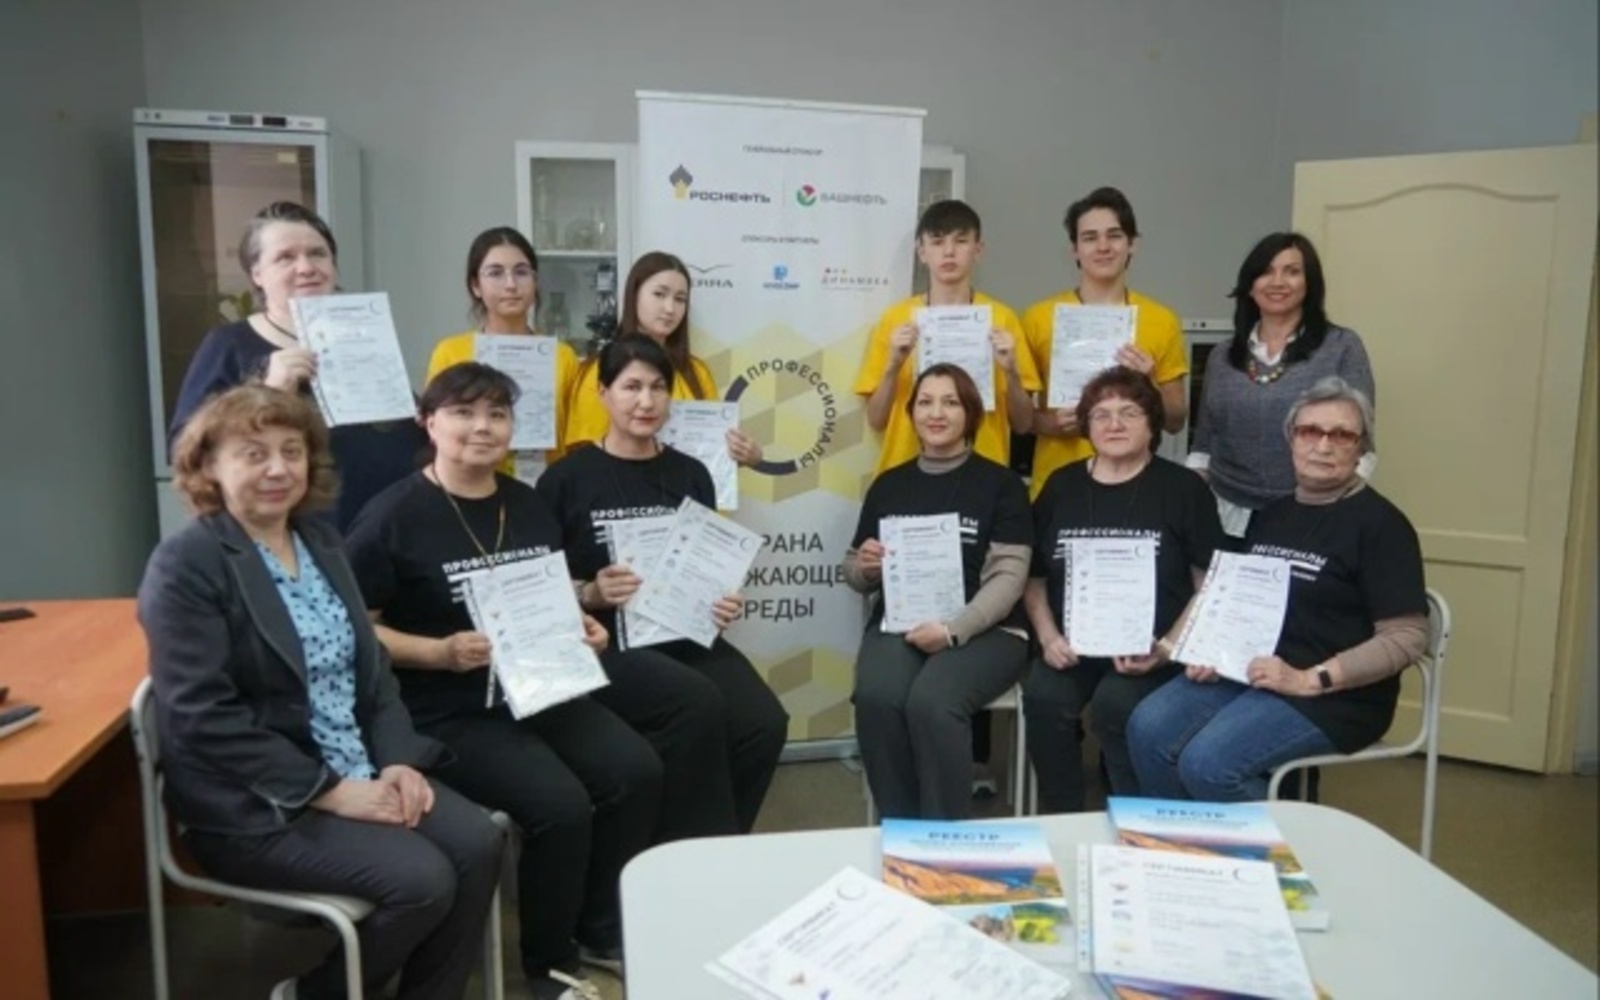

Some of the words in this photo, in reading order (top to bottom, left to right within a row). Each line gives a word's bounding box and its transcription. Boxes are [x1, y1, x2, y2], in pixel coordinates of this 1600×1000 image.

[690, 190, 771, 204] РОСНЕФТЬ
[821, 192, 887, 206] БАШНЕФТЬ
[747, 358, 836, 468] ПРОФЕССИОНАЛЫ
[761, 532, 824, 553] РАНА
[744, 564, 848, 588] ЖАЮЩЕ
